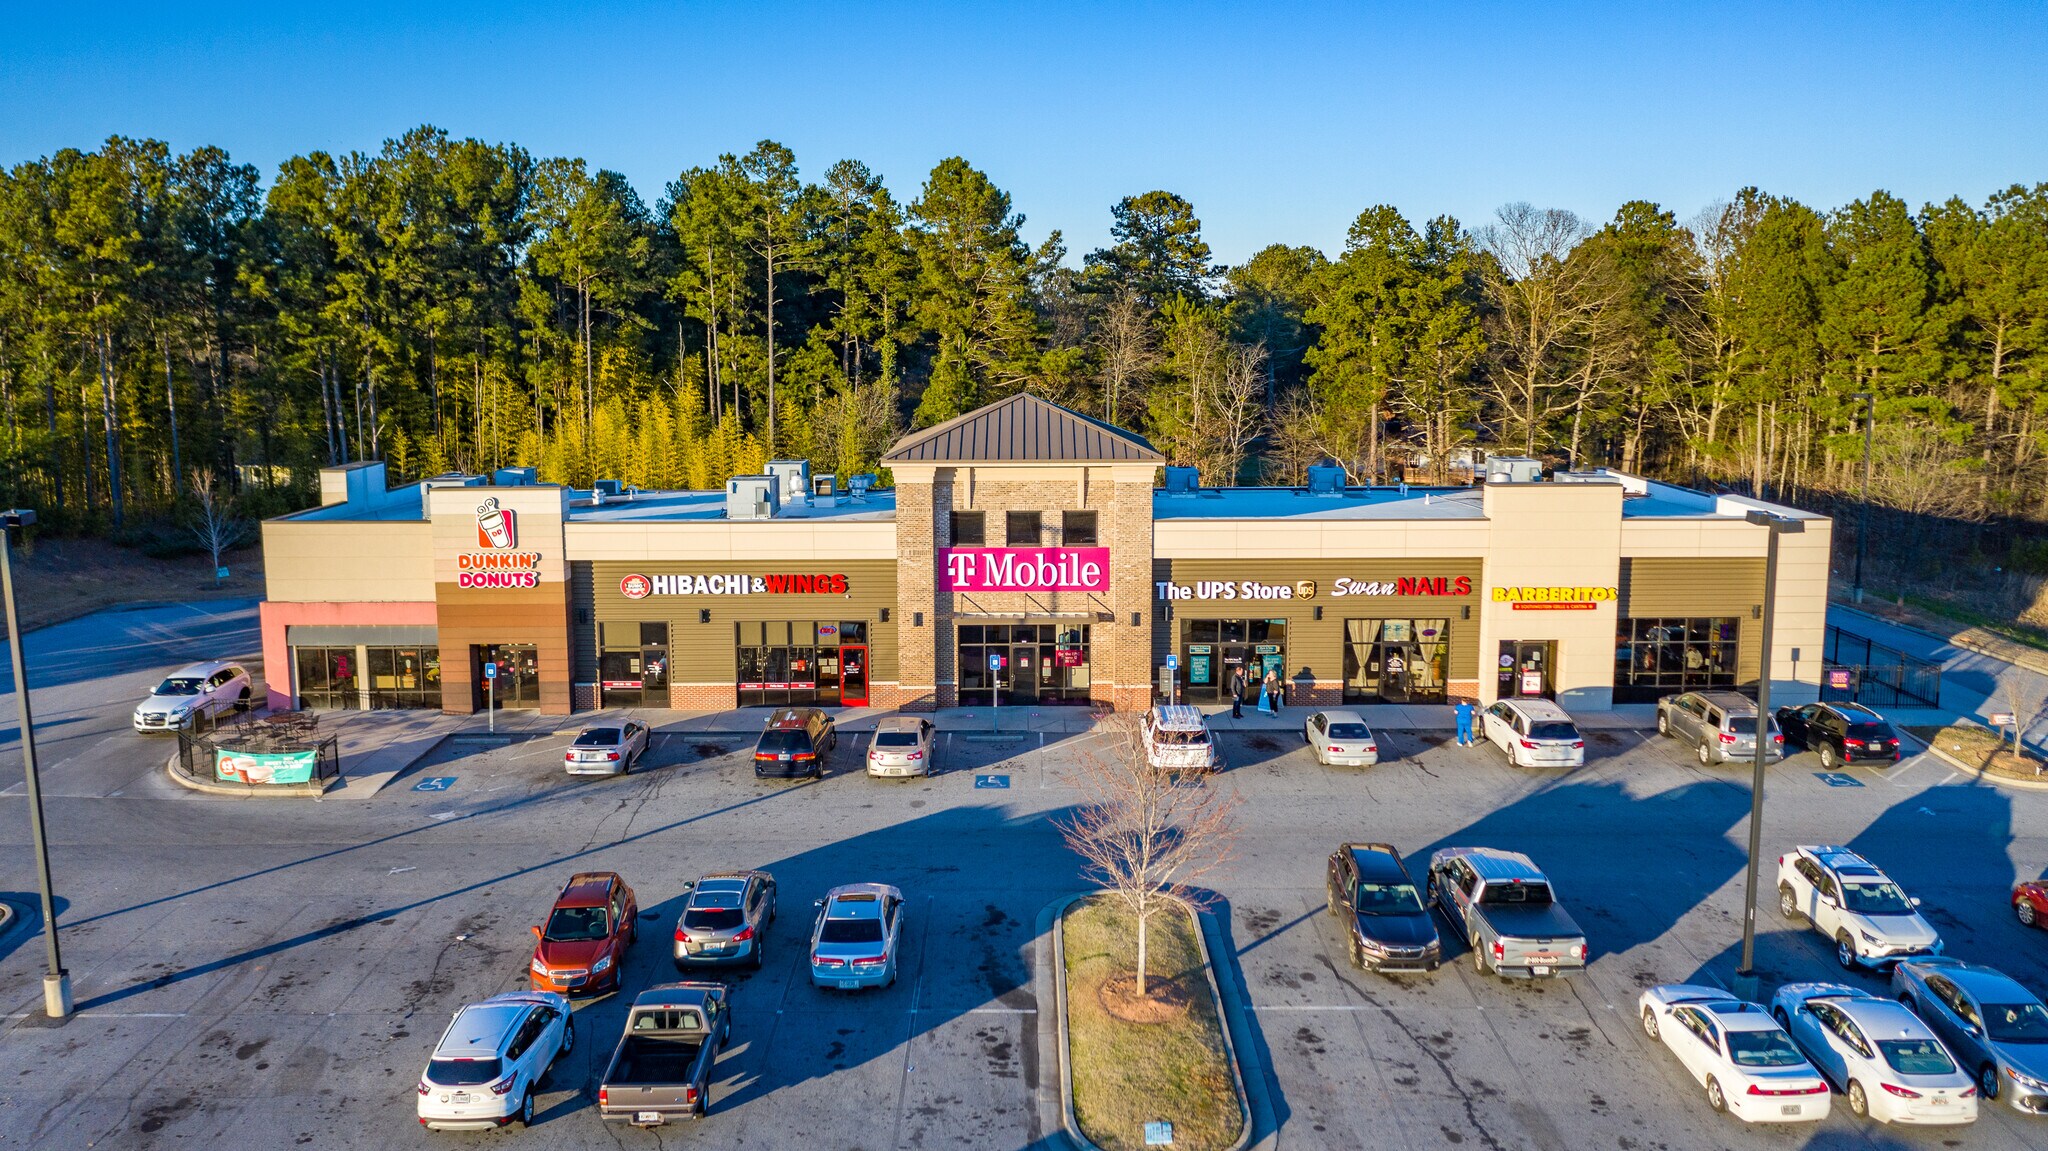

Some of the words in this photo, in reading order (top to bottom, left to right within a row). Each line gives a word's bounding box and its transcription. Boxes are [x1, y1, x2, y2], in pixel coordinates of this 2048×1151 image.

[491, 529, 503, 537] DD
[458, 553, 537, 569] DUNKIN'
[982, 553, 1101, 587] Mobile
[459, 572, 536, 587] DONUTS
[652, 574, 749, 595] HIBACHI
[752, 577, 766, 593] &
[765, 574, 848, 594] WINGS
[1331, 577, 1397, 596] Swan
[1397, 575, 1472, 596] NAILS
[1156, 581, 1192, 600] The
[1196, 581, 1237, 600] UPS
[1241, 581, 1292, 600] Store
[1298, 586, 1314, 597] ups
[1492, 587, 1618, 602] BARBERITOS
